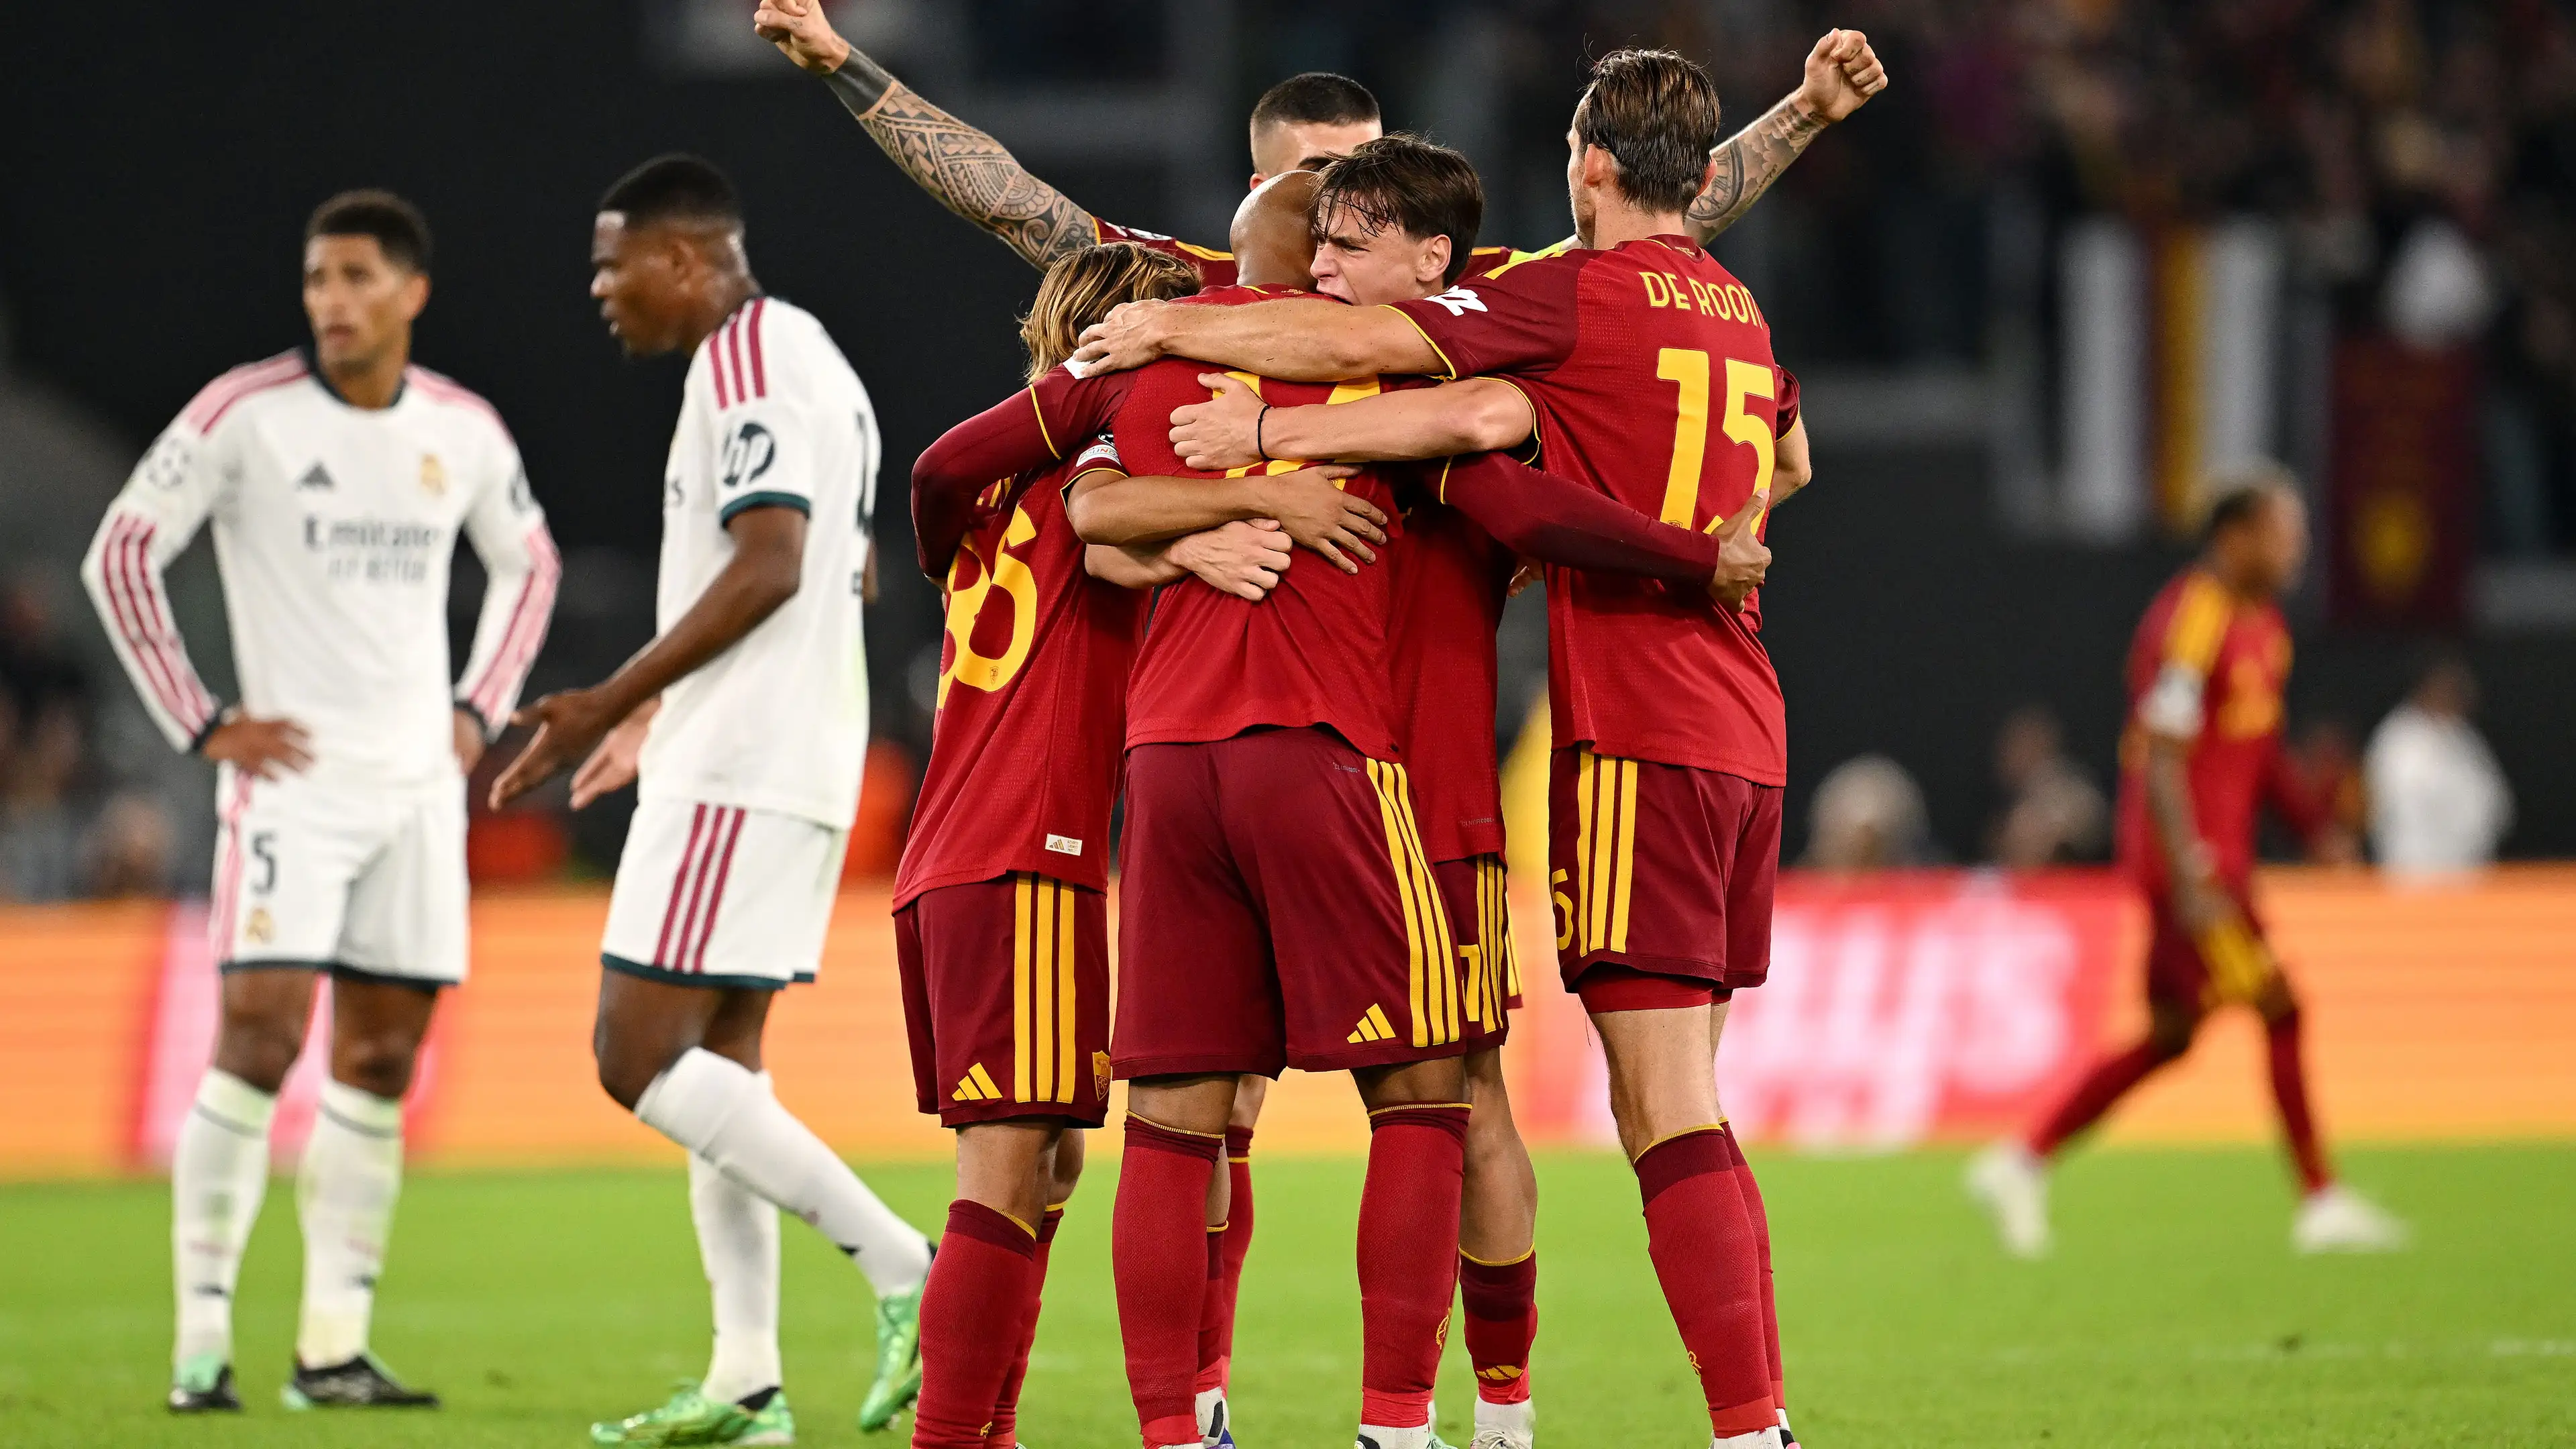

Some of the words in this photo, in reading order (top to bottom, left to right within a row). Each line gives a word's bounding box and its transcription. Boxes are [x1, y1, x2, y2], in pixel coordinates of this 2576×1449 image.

[1638, 271, 1691, 309] DE
[1656, 347, 1775, 537] 15
[252, 831, 276, 894] 5
